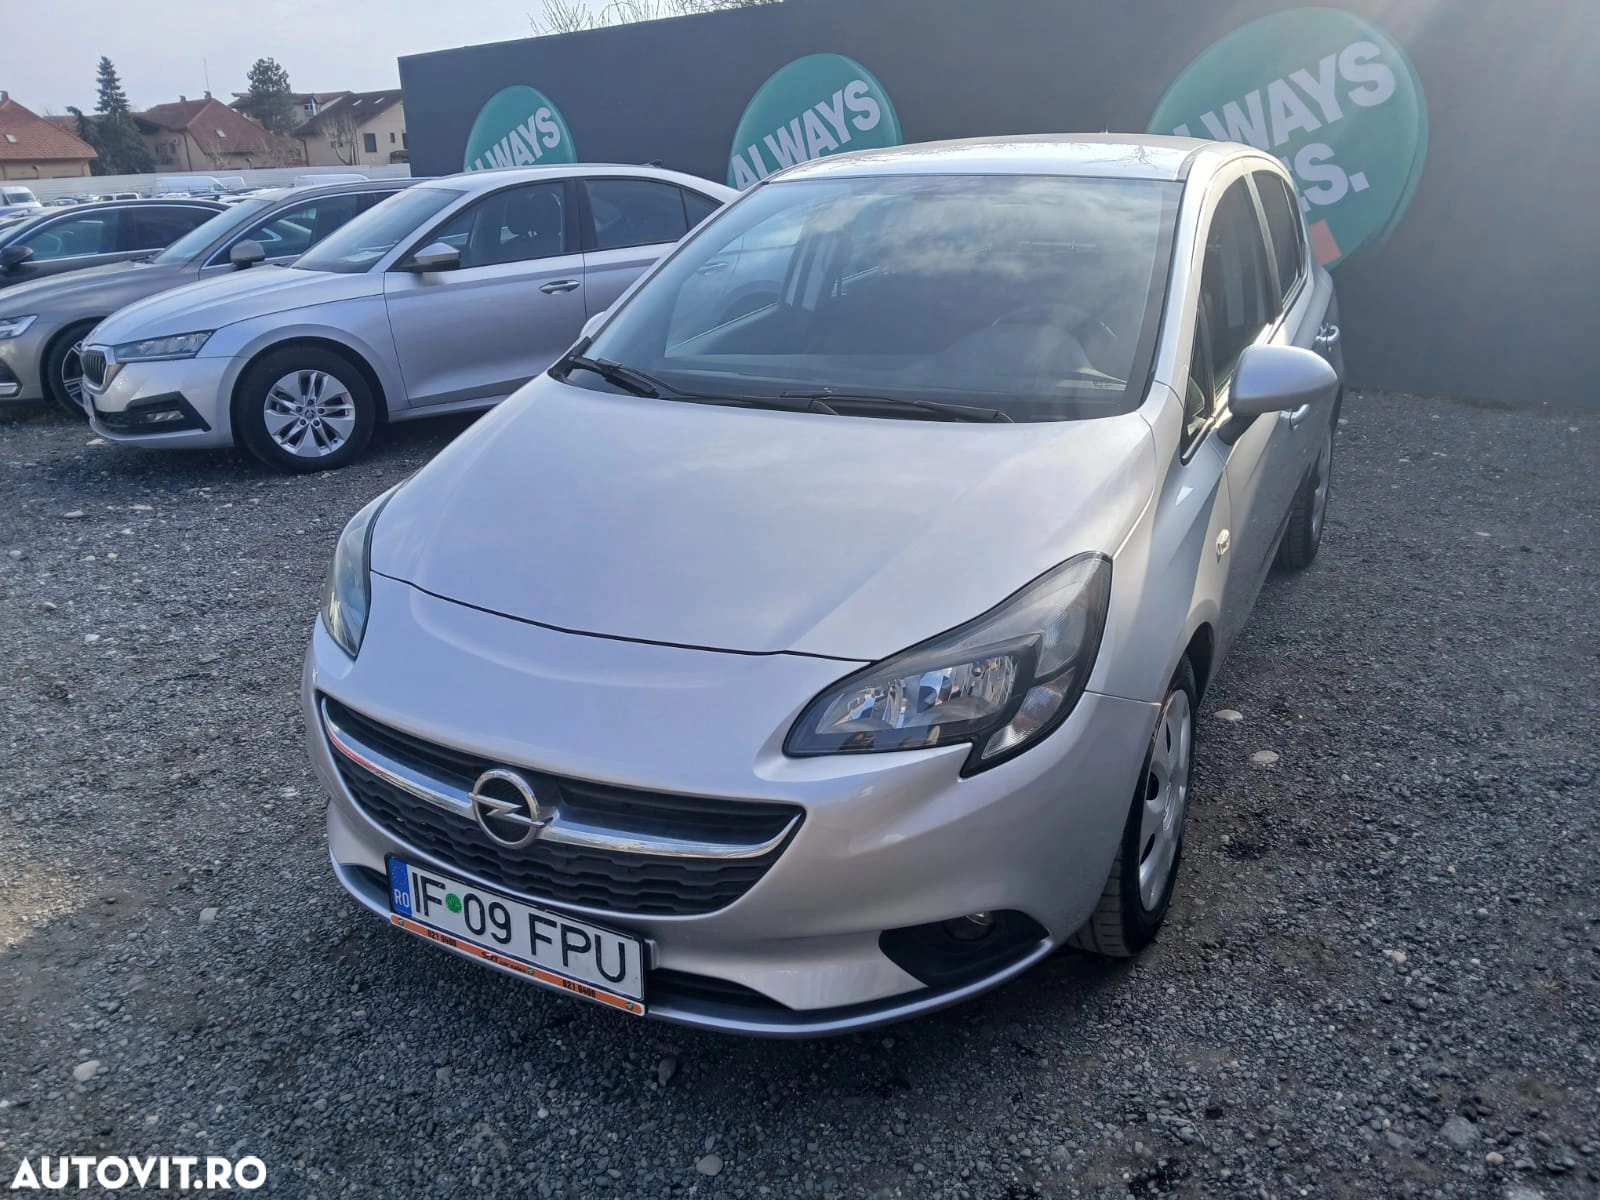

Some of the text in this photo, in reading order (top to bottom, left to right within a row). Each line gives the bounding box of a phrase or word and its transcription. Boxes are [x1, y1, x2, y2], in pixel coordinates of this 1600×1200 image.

[393, 888, 411, 909] RO
[411, 871, 446, 917] IF
[463, 892, 512, 945] 09
[528, 911, 626, 984] FPU
